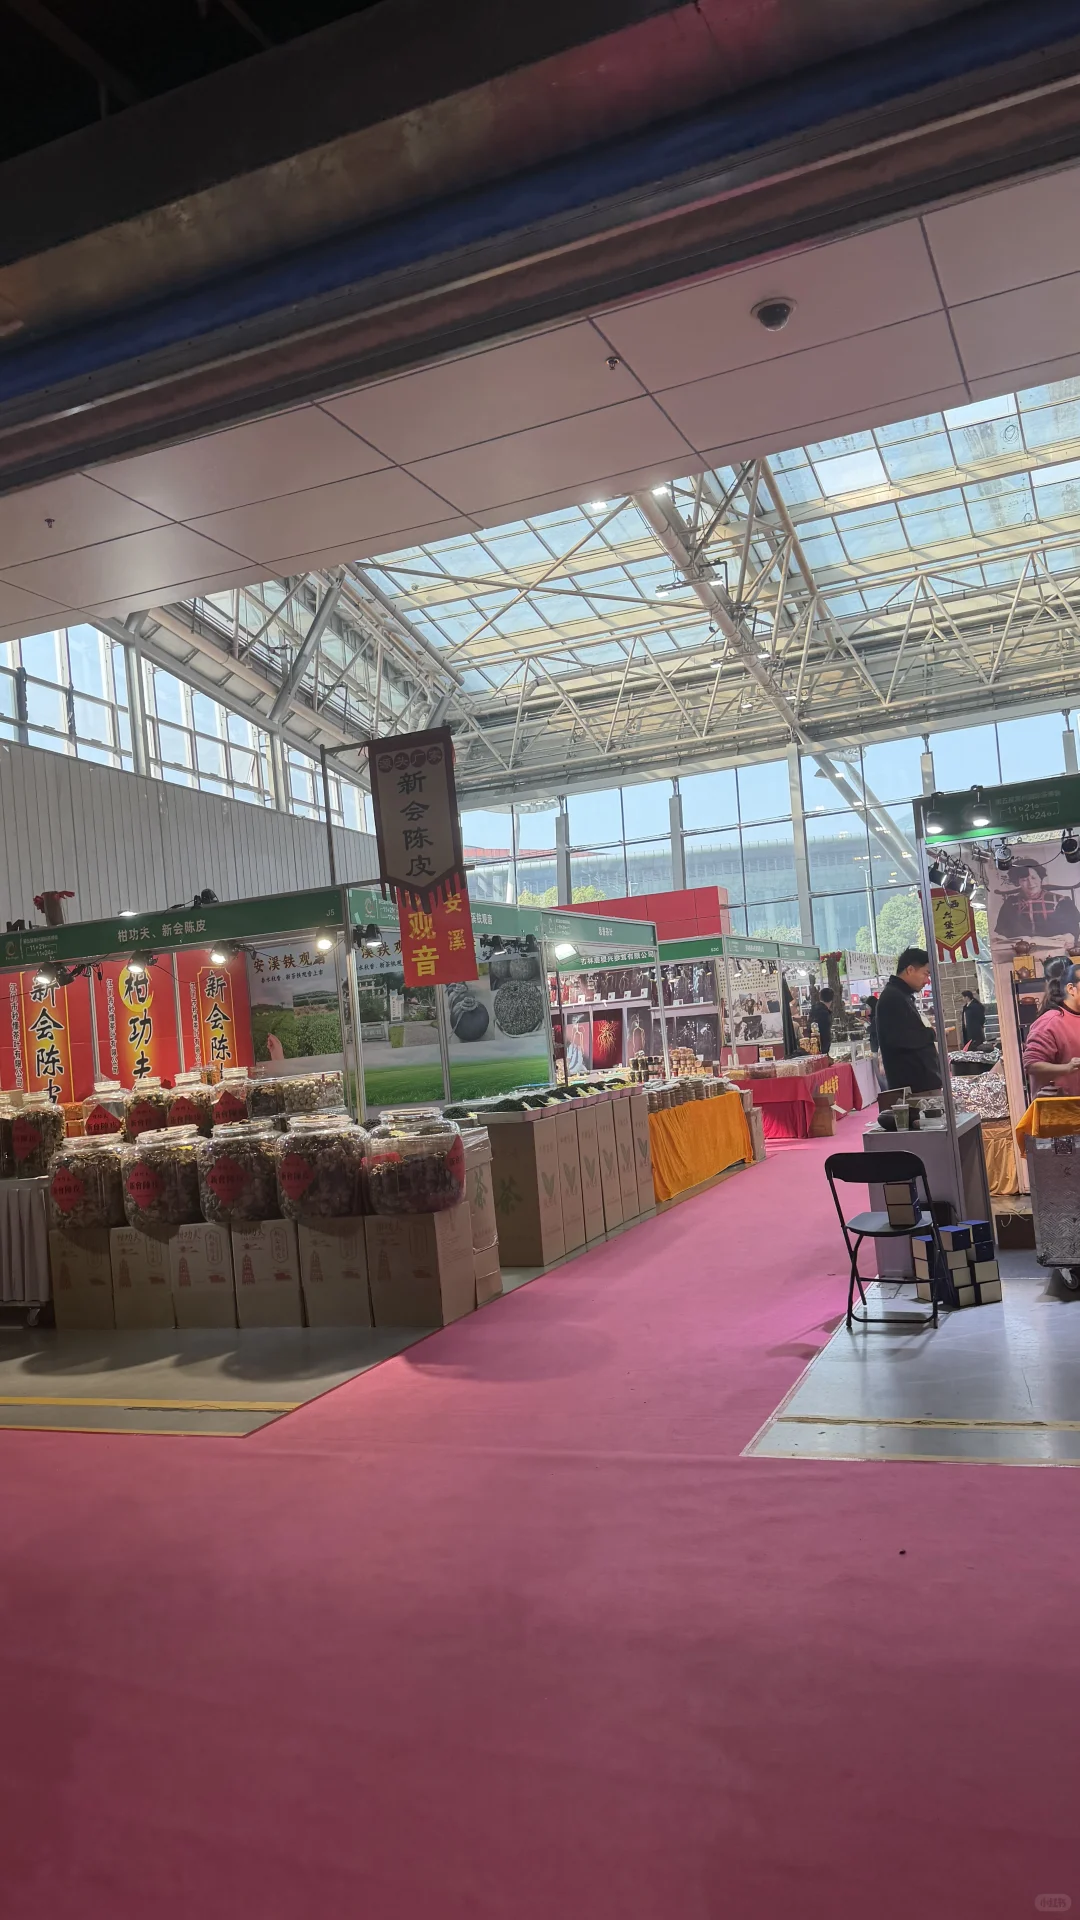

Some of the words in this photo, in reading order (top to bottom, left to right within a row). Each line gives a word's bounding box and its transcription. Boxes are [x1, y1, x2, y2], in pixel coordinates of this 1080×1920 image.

[397, 770, 437, 877] 新会陈皮
[117, 919, 207, 943] 柑功夫、新会陈皮
[253, 950, 328, 974] 安溪铁观音
[205, 969, 231, 1079] 新会陈
